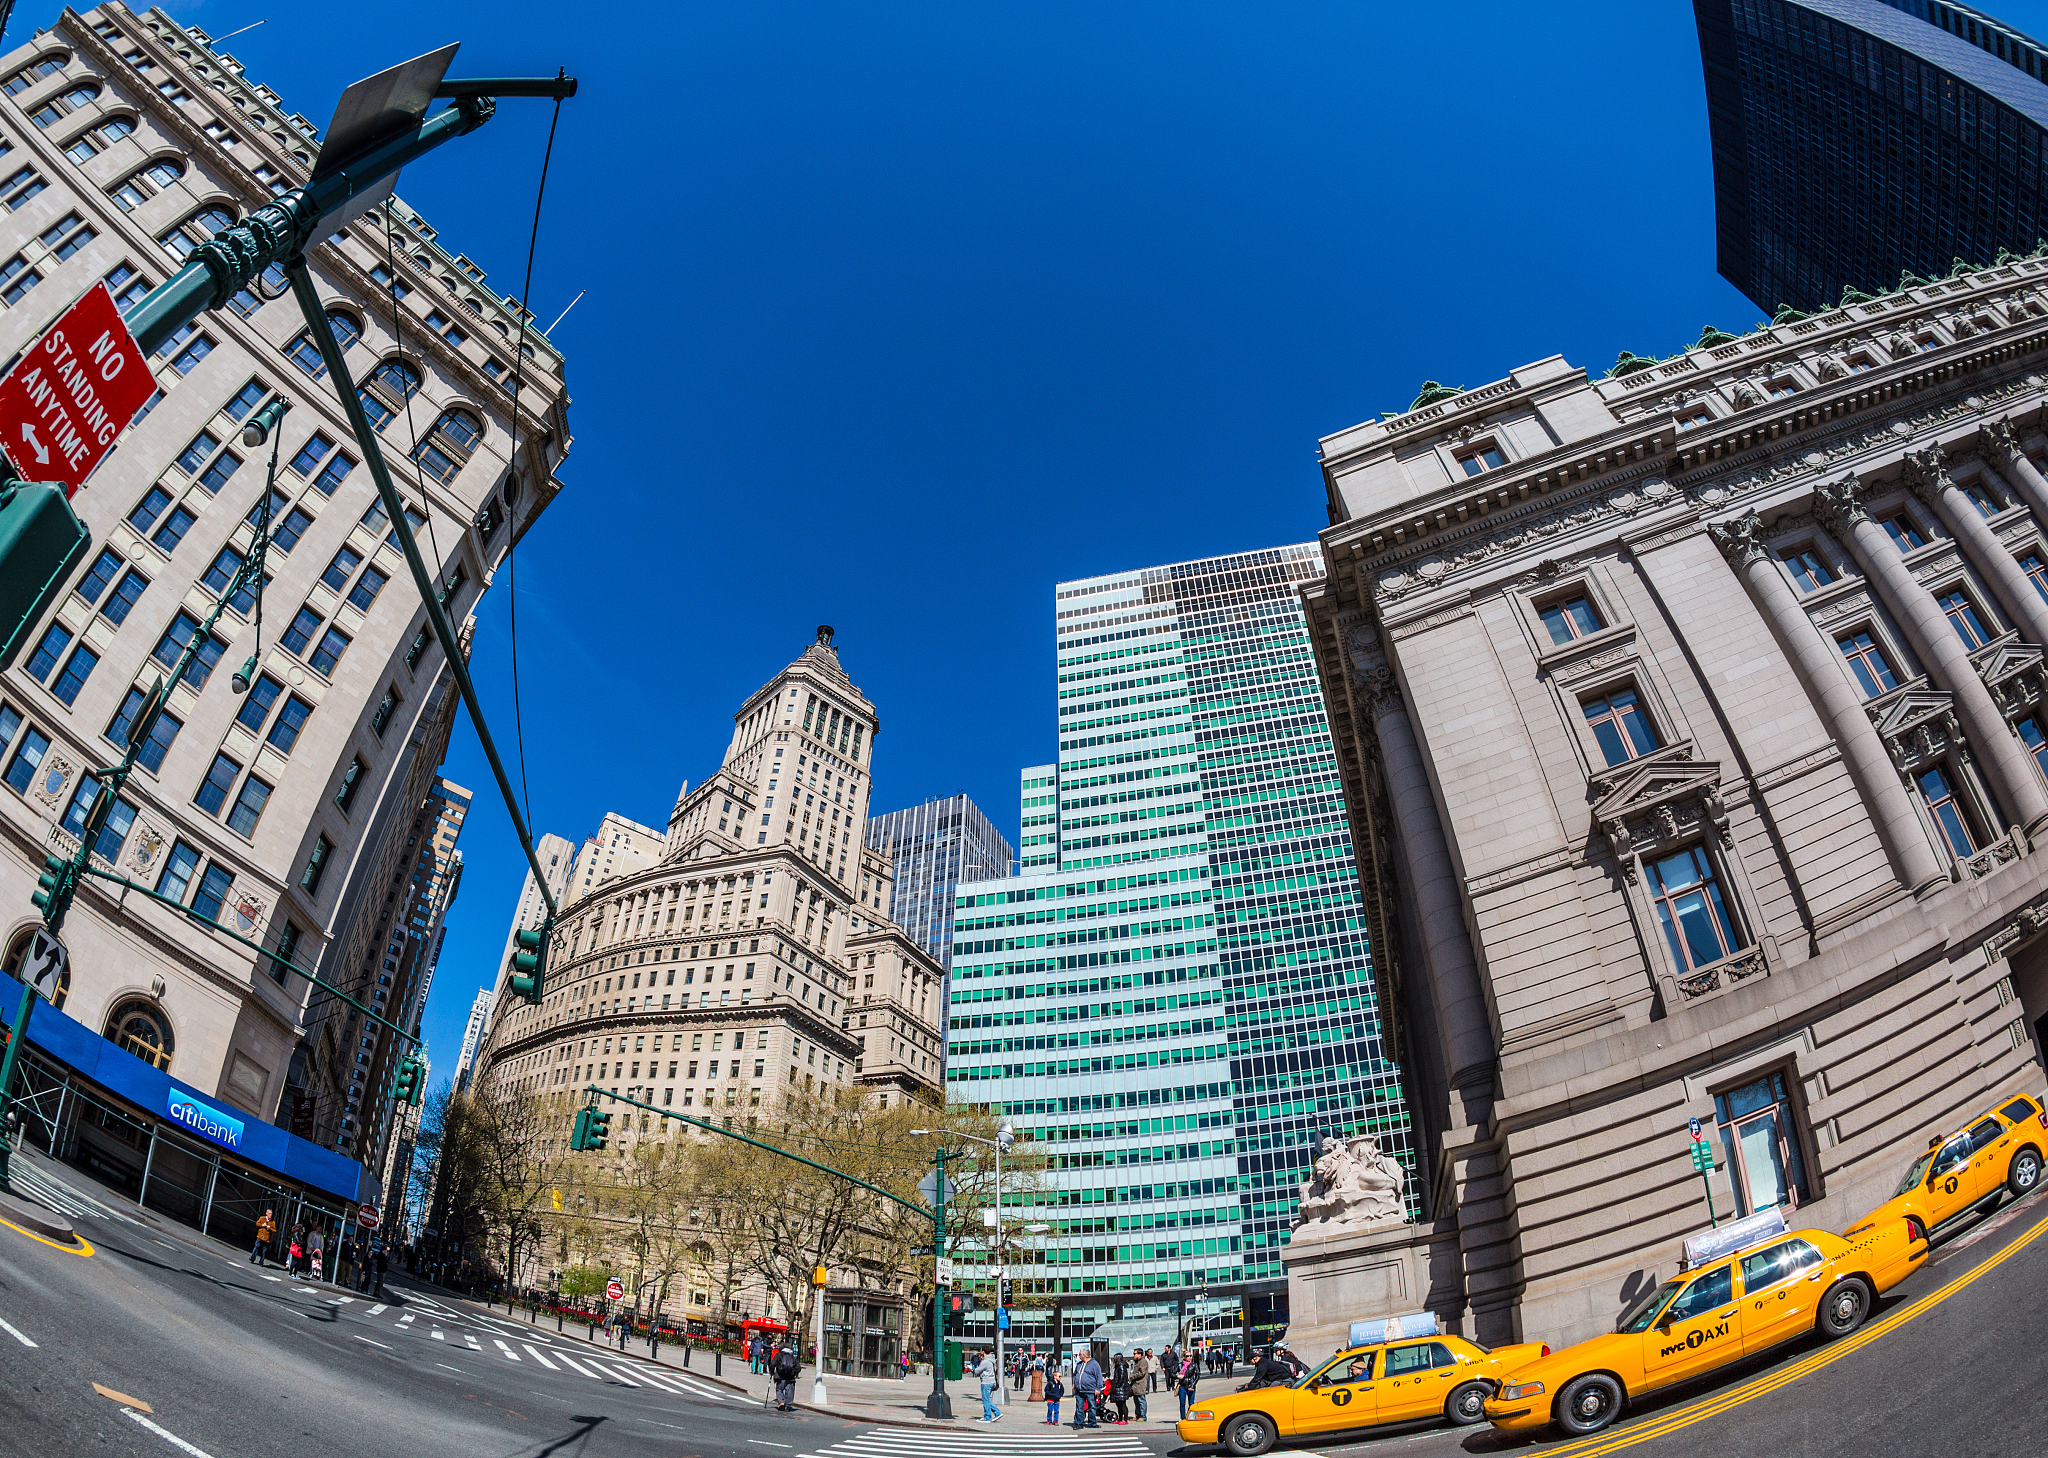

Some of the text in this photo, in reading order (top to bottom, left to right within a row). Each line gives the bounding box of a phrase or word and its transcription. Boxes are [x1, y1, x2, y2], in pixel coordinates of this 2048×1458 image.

[88, 330, 125, 381] NO
[45, 330, 116, 446] STANDING
[21, 367, 90, 472] ANYTIME
[170, 1103, 238, 1147] citibank
[1946, 1178, 1956, 1193] T
[937, 1266, 952, 1275] TRAFFIC
[940, 1259, 950, 1268] ALL
[1014, 1338, 1037, 1347] LOFT
[1660, 1322, 1729, 1357] NYC TAXI
[1334, 1390, 1350, 1405] T
